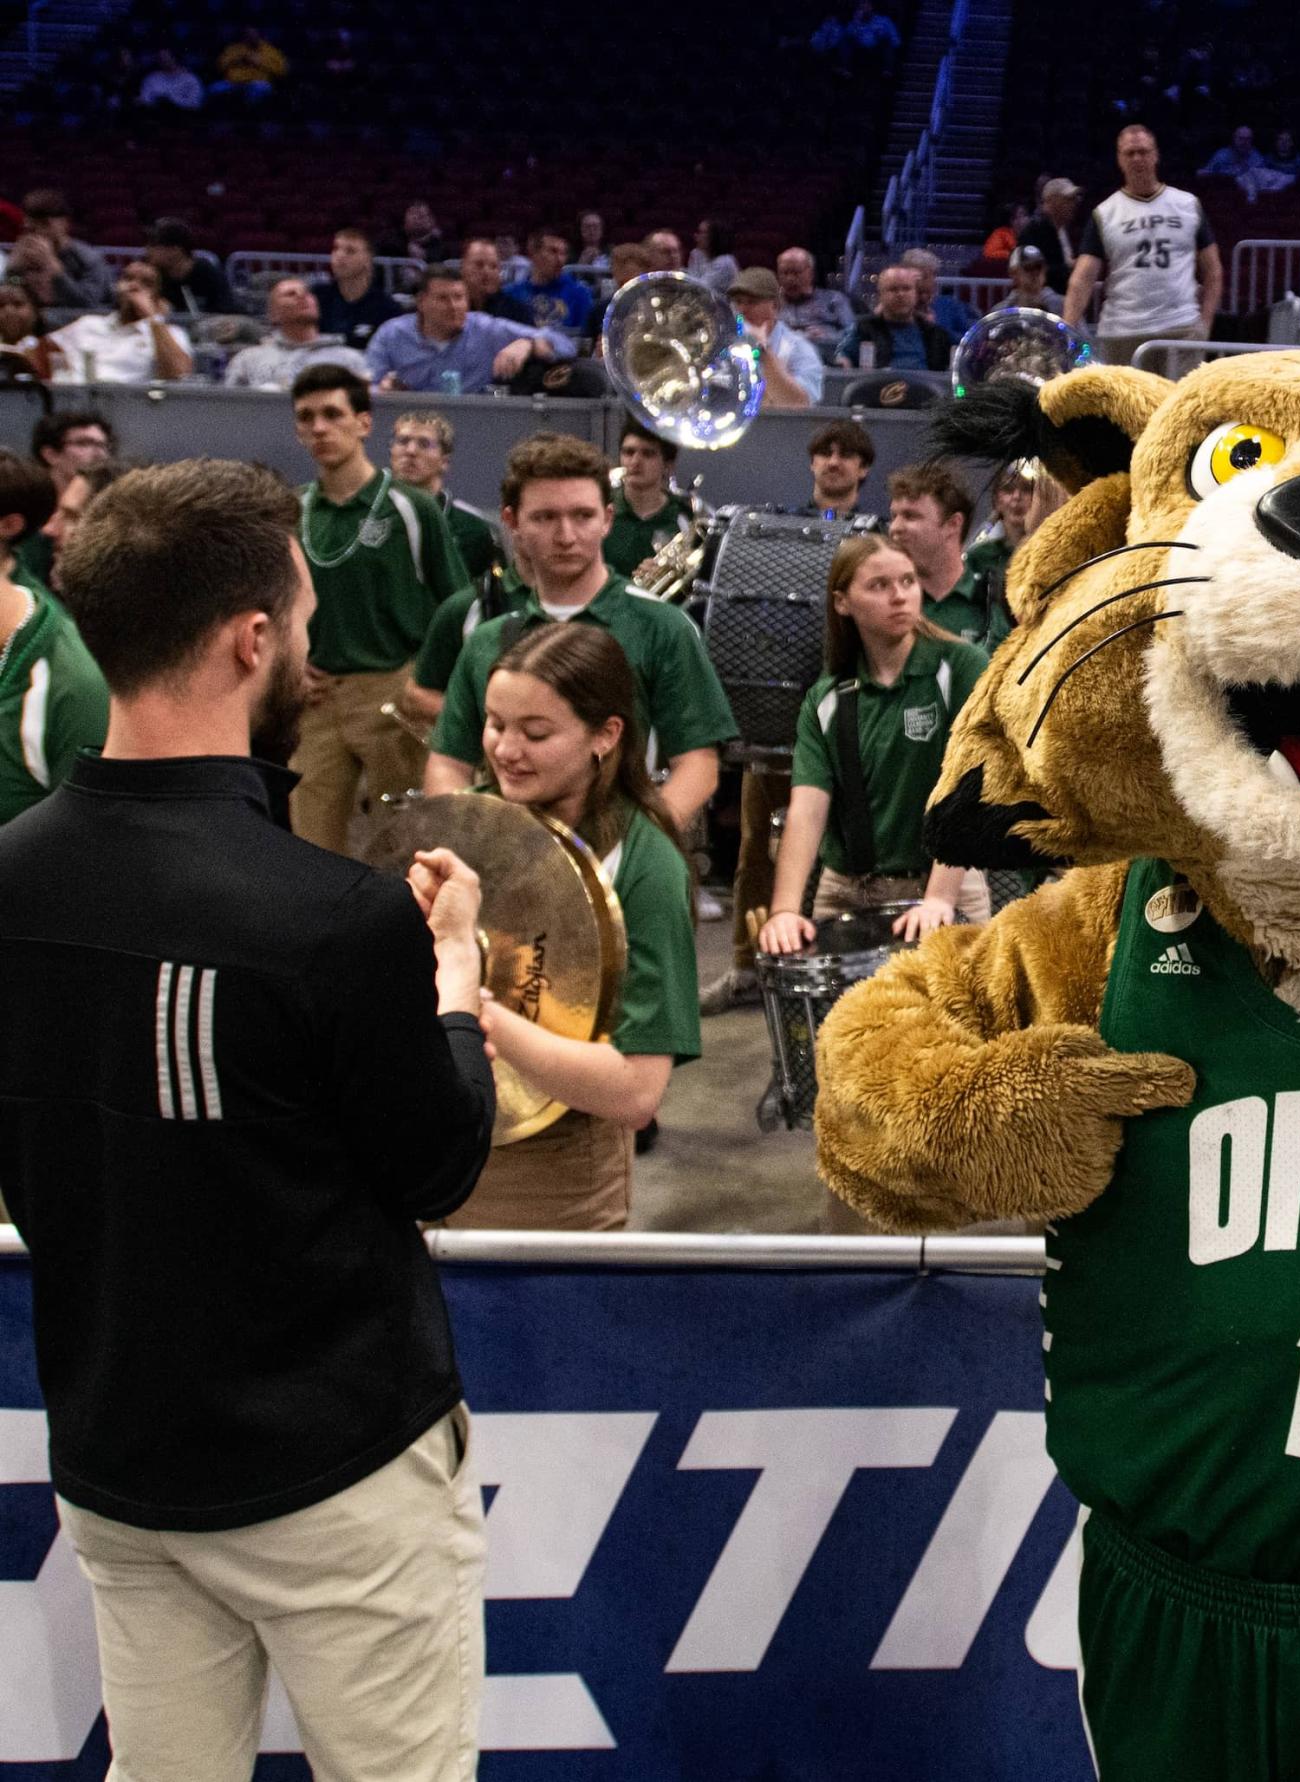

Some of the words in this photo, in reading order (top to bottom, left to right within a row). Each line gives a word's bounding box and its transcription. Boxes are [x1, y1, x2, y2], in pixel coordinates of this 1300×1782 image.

[1121, 215, 1183, 234] ZIPS
[1135, 239, 1171, 268] 25
[1150, 959, 1201, 975] adidas
